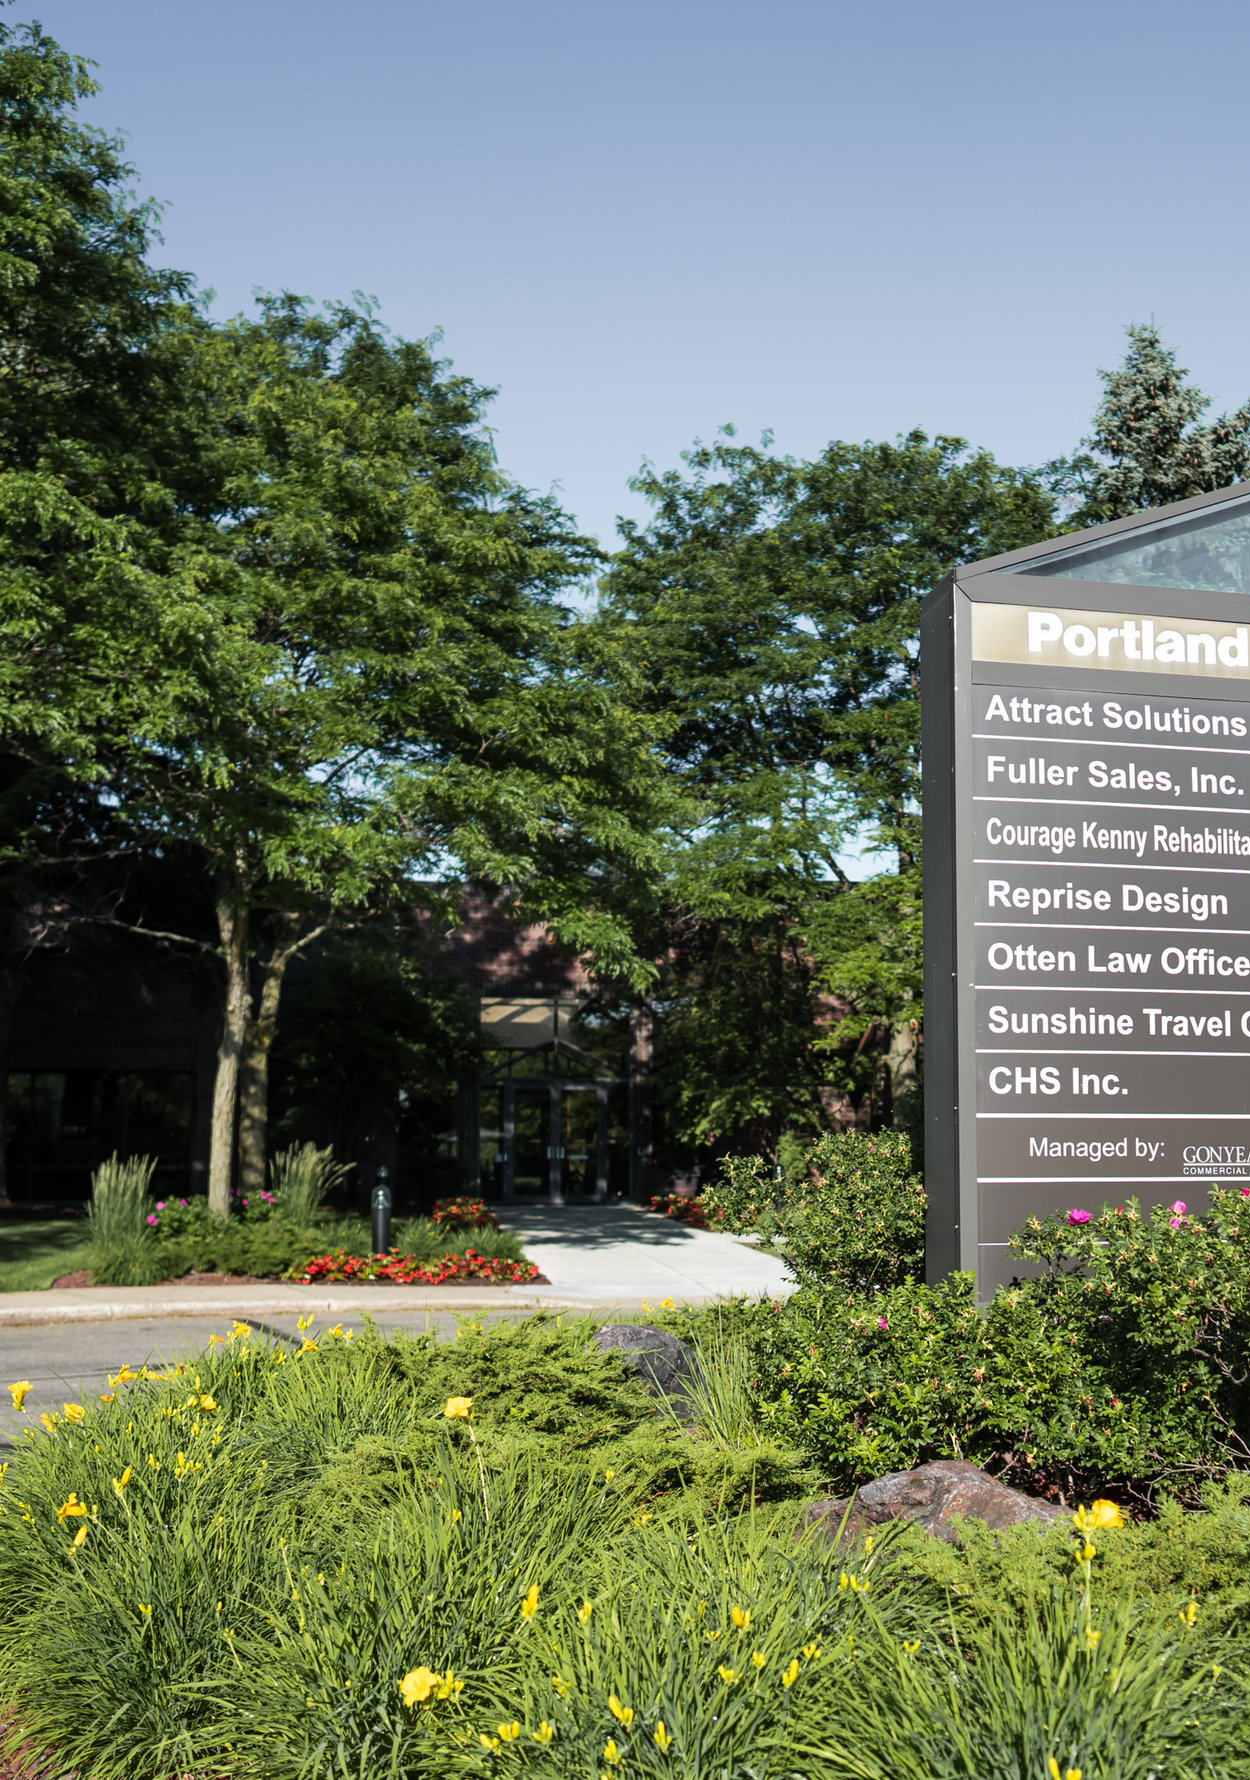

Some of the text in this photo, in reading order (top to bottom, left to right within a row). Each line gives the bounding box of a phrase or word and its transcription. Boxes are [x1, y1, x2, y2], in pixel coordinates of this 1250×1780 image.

[1027, 611, 1249, 667] Portland
[984, 694, 1248, 737] Attract Solutions
[987, 755, 1244, 797] Fuller Sales, Inc.
[986, 816, 1076, 855] Courage
[1082, 821, 1148, 858] Kenny
[987, 879, 1228, 921] Reprise Design
[987, 942, 1250, 977] Otten Law Office
[987, 1005, 1134, 1036] Sunshine
[1142, 1008, 1232, 1037] Travel
[988, 1066, 1129, 1096] CHS Inc.
[1029, 1136, 1165, 1162] Managed by:
[1182, 1166, 1247, 1175] COMMERCIAL
